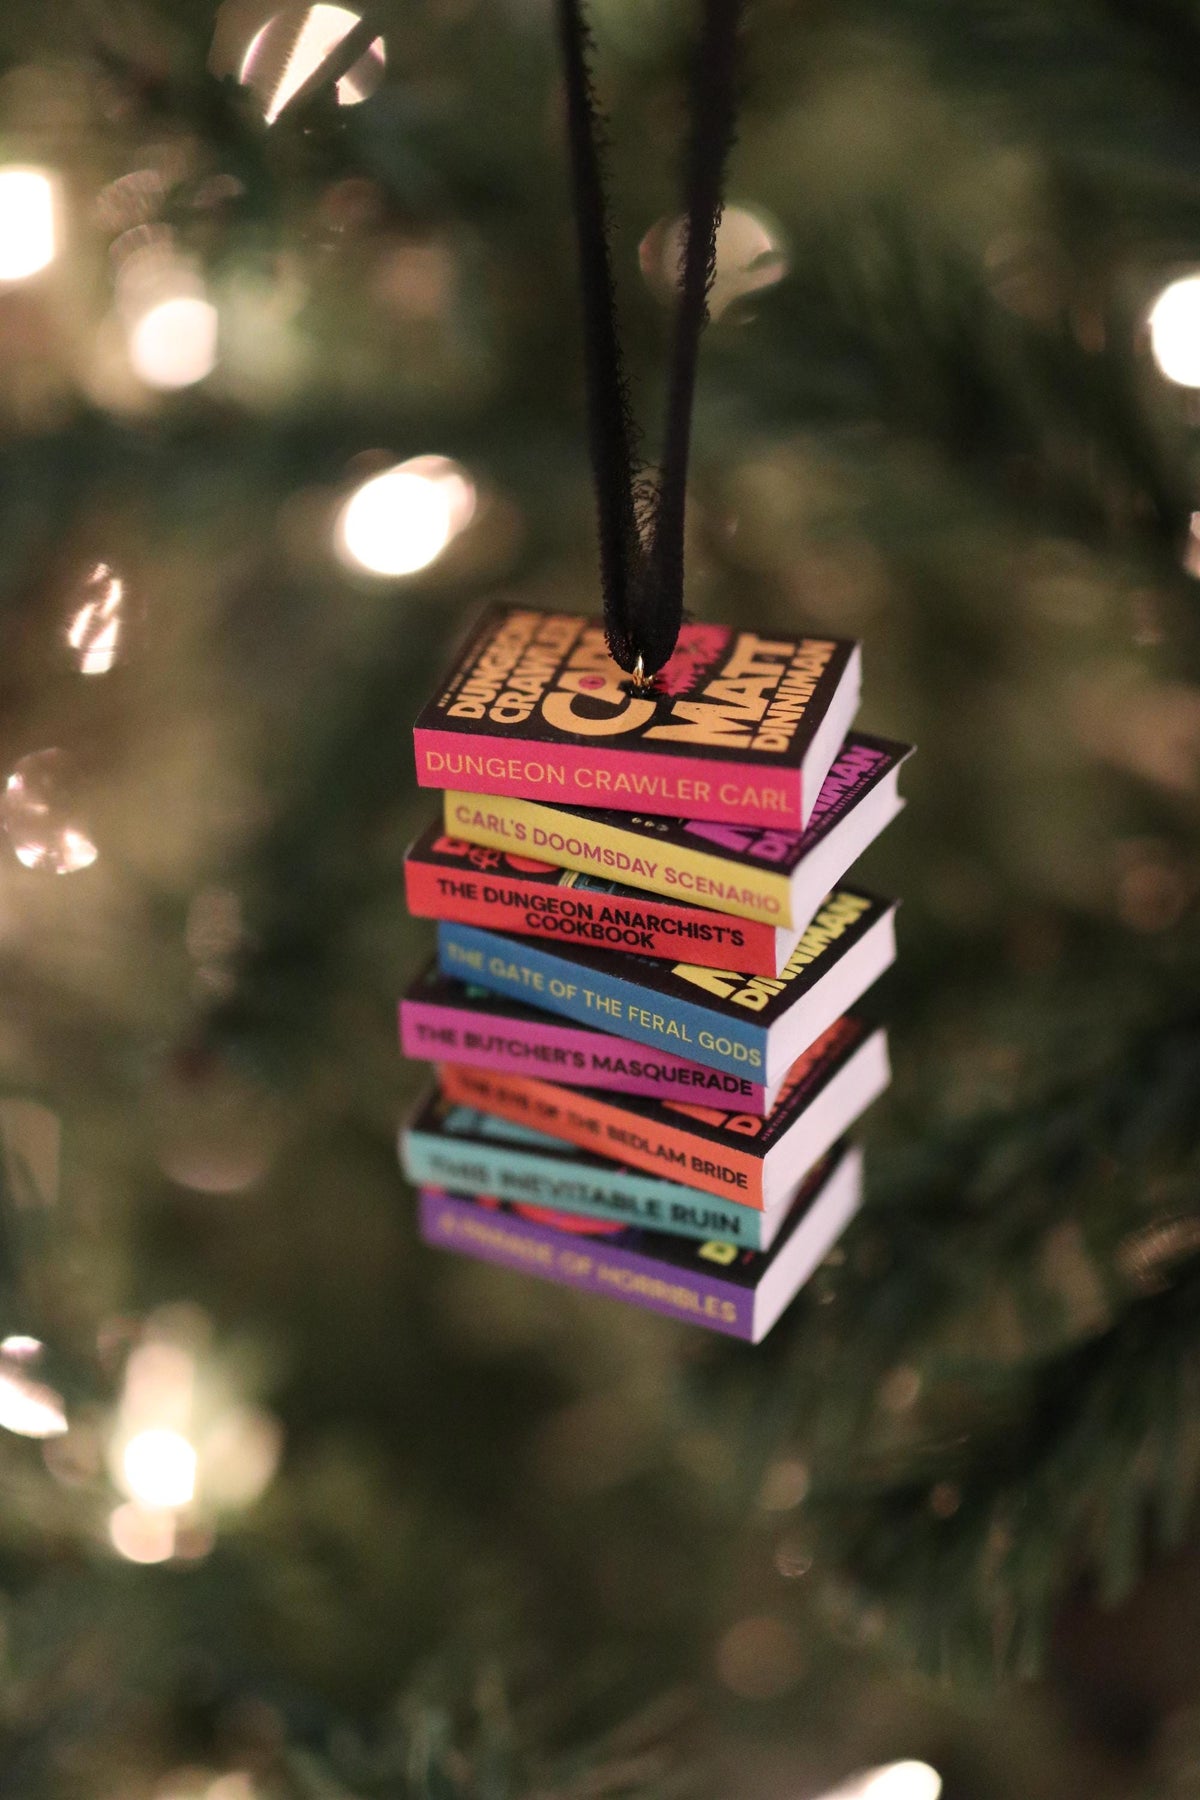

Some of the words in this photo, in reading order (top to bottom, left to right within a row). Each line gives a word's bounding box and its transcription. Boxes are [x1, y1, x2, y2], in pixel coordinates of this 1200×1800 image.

[446, 610, 543, 719] DUNGEON
[489, 616, 586, 724] CRAWLER
[642, 633, 796, 748] MATT
[751, 638, 838, 752] DINNIMAN
[425, 751, 566, 785] DUNGEON
[574, 768, 711, 802] CRAWLER
[719, 784, 794, 814] CARL
[455, 805, 527, 841] CARL'S
[533, 828, 657, 879] DOOMSDAY
[664, 867, 780, 914] SCENARIO
[437, 878, 478, 900] THE
[482, 887, 594, 920] DUNGEON
[599, 907, 744, 947] ANARCHIST'S
[525, 913, 655, 950] COOKBOOK
[447, 942, 484, 971] THE
[489, 957, 544, 991] GATE
[549, 980, 577, 1001] OF
[582, 989, 623, 1019] THE
[628, 1007, 693, 1043] FERAL
[698, 1031, 762, 1068] GODS
[416, 1023, 458, 1046] THE
[463, 1031, 586, 1068] BUTCHER'S
[592, 1054, 753, 1097] MASQUERADE
[607, 1123, 687, 1166] BEDLAM
[691, 1158, 748, 1190] BRIDE
[669, 1202, 740, 1236] RUIN
